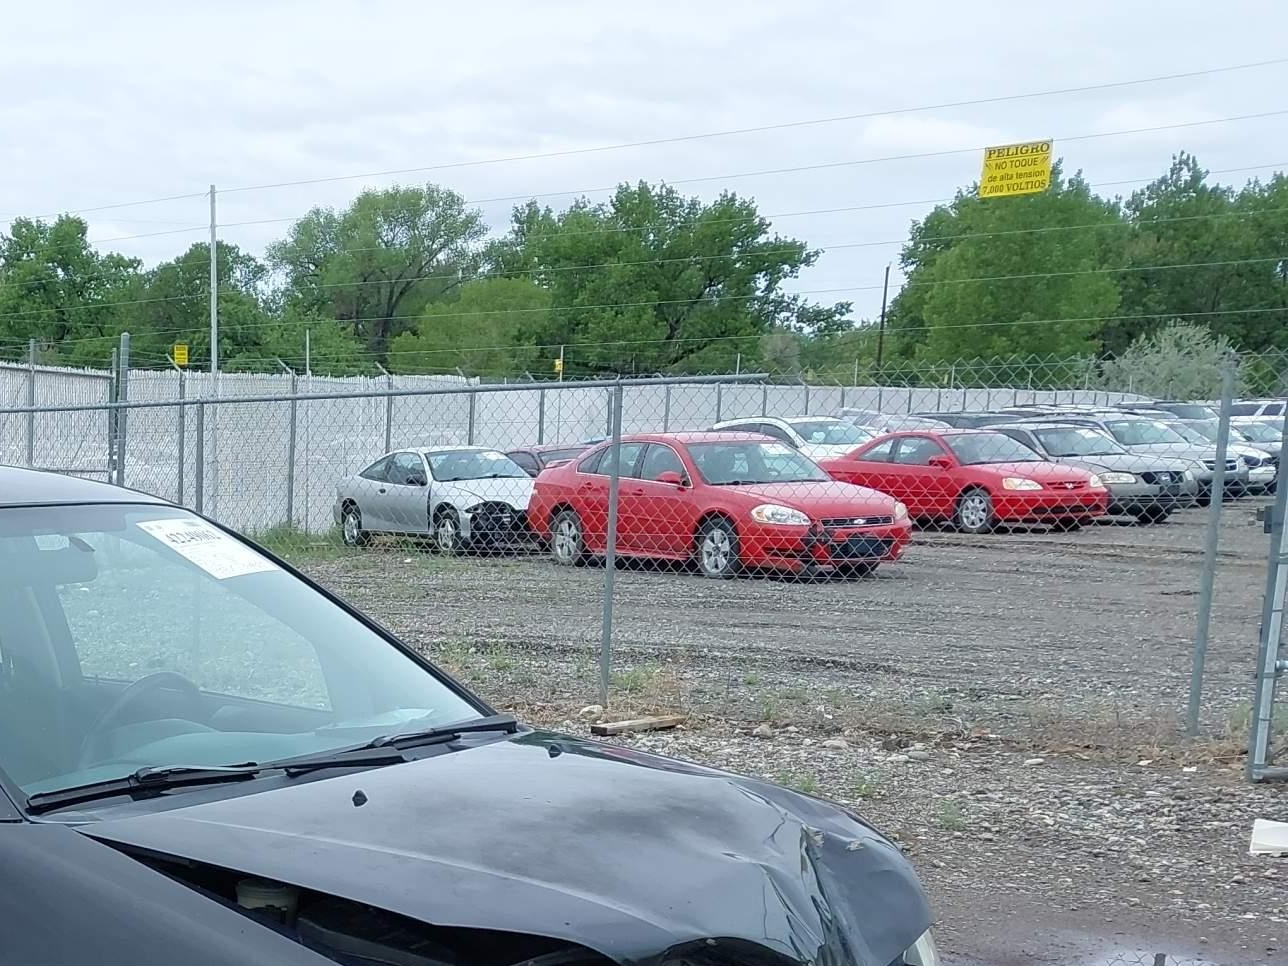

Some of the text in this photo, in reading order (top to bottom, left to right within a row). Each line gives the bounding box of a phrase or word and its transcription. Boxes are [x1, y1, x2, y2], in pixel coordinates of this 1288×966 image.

[987, 142, 1050, 159] PELIGRO
[995, 157, 1039, 170] NO TOQUE
[987, 169, 1045, 183] de alta tension
[1006, 179, 1047, 192] VOLTIOS
